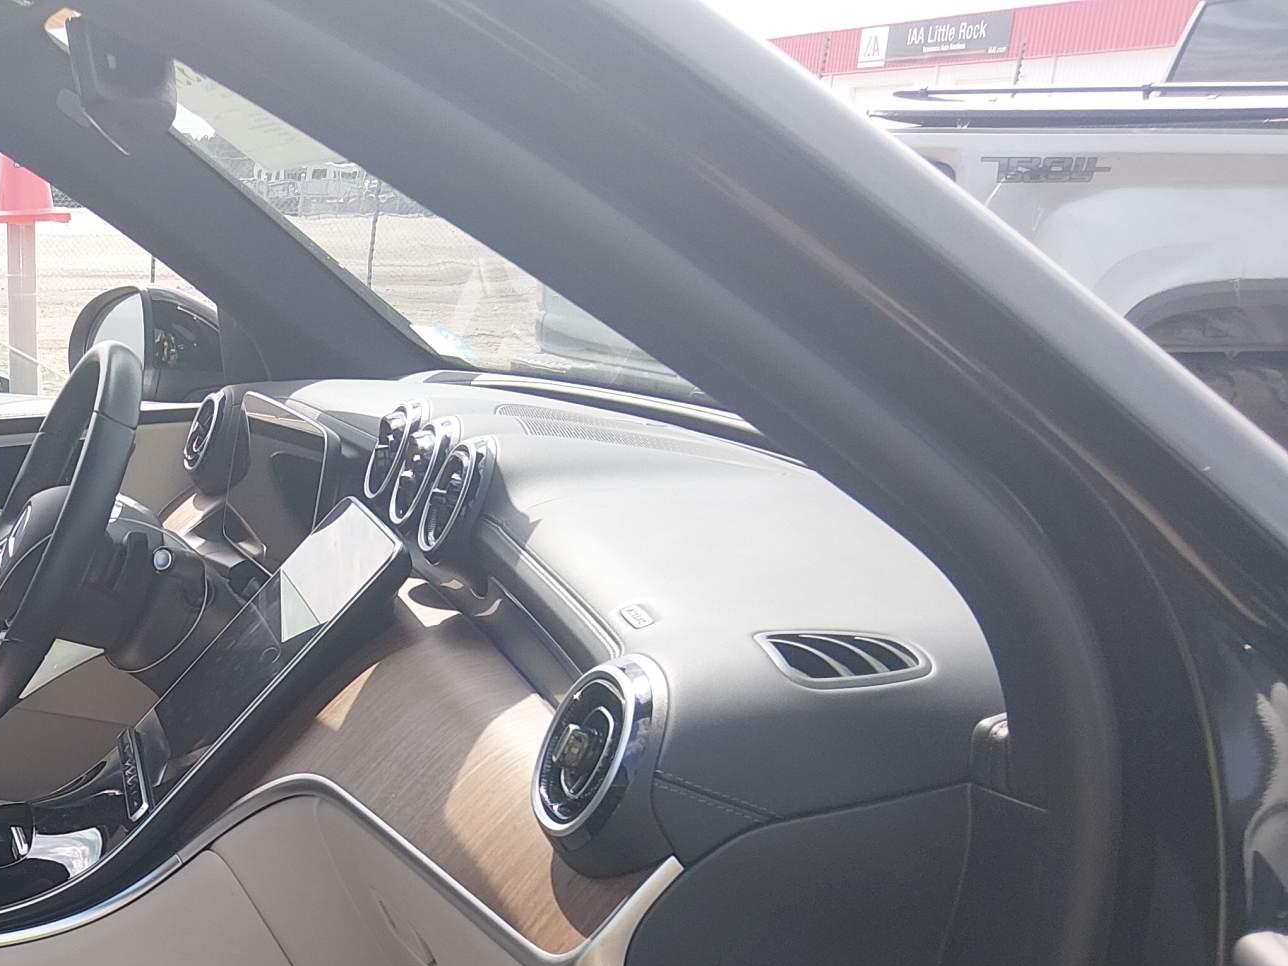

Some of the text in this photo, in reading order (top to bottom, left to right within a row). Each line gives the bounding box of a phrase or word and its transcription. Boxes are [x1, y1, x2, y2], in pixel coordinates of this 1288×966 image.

[907, 19, 988, 45] IAA Little Rock
